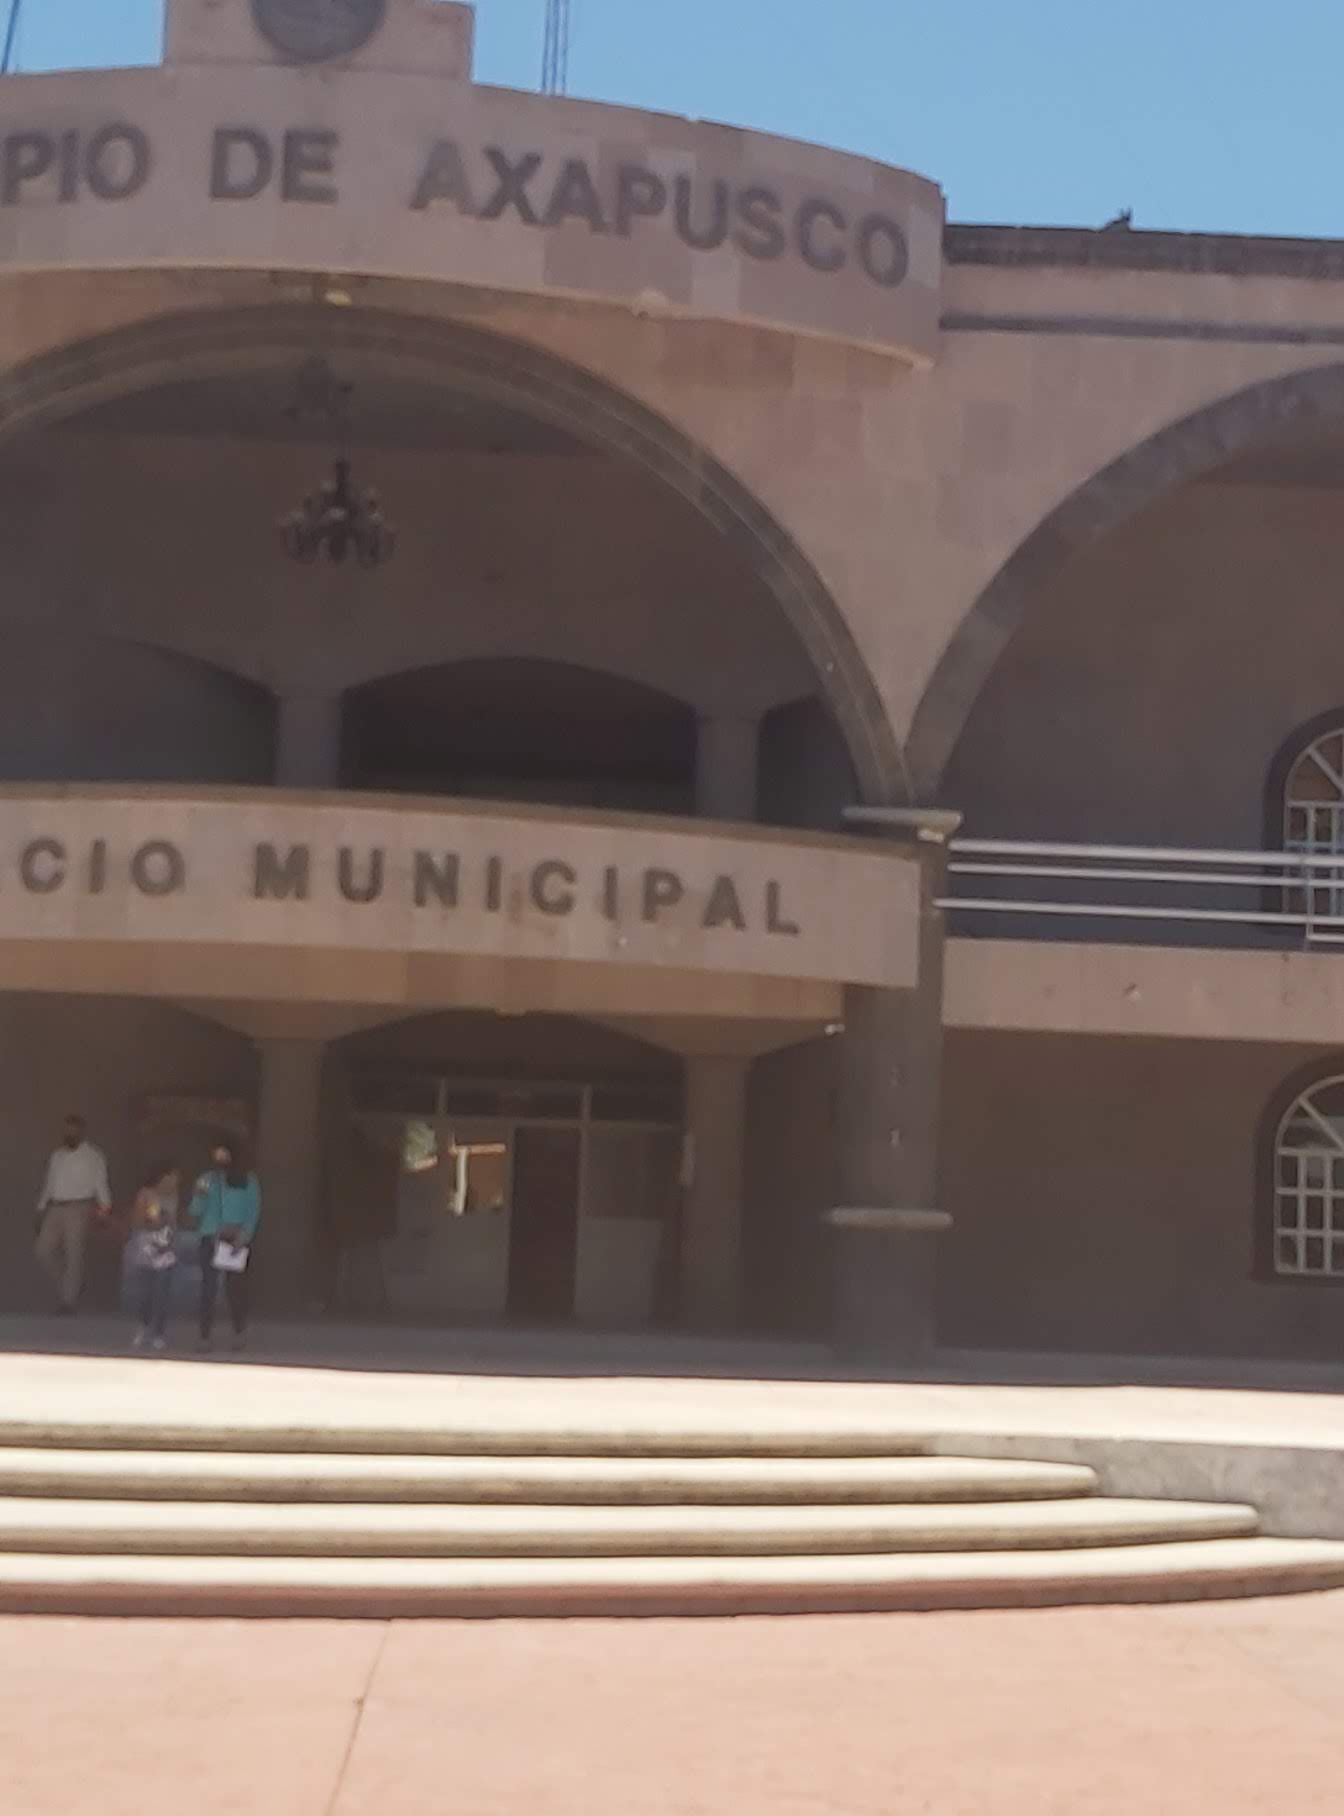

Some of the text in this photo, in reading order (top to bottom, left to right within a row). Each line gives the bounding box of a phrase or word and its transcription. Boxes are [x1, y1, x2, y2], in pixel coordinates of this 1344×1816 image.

[209, 127, 340, 204] DE
[408, 139, 910, 288] AXAPUSCO
[253, 842, 801, 936] MUNICIPAL
